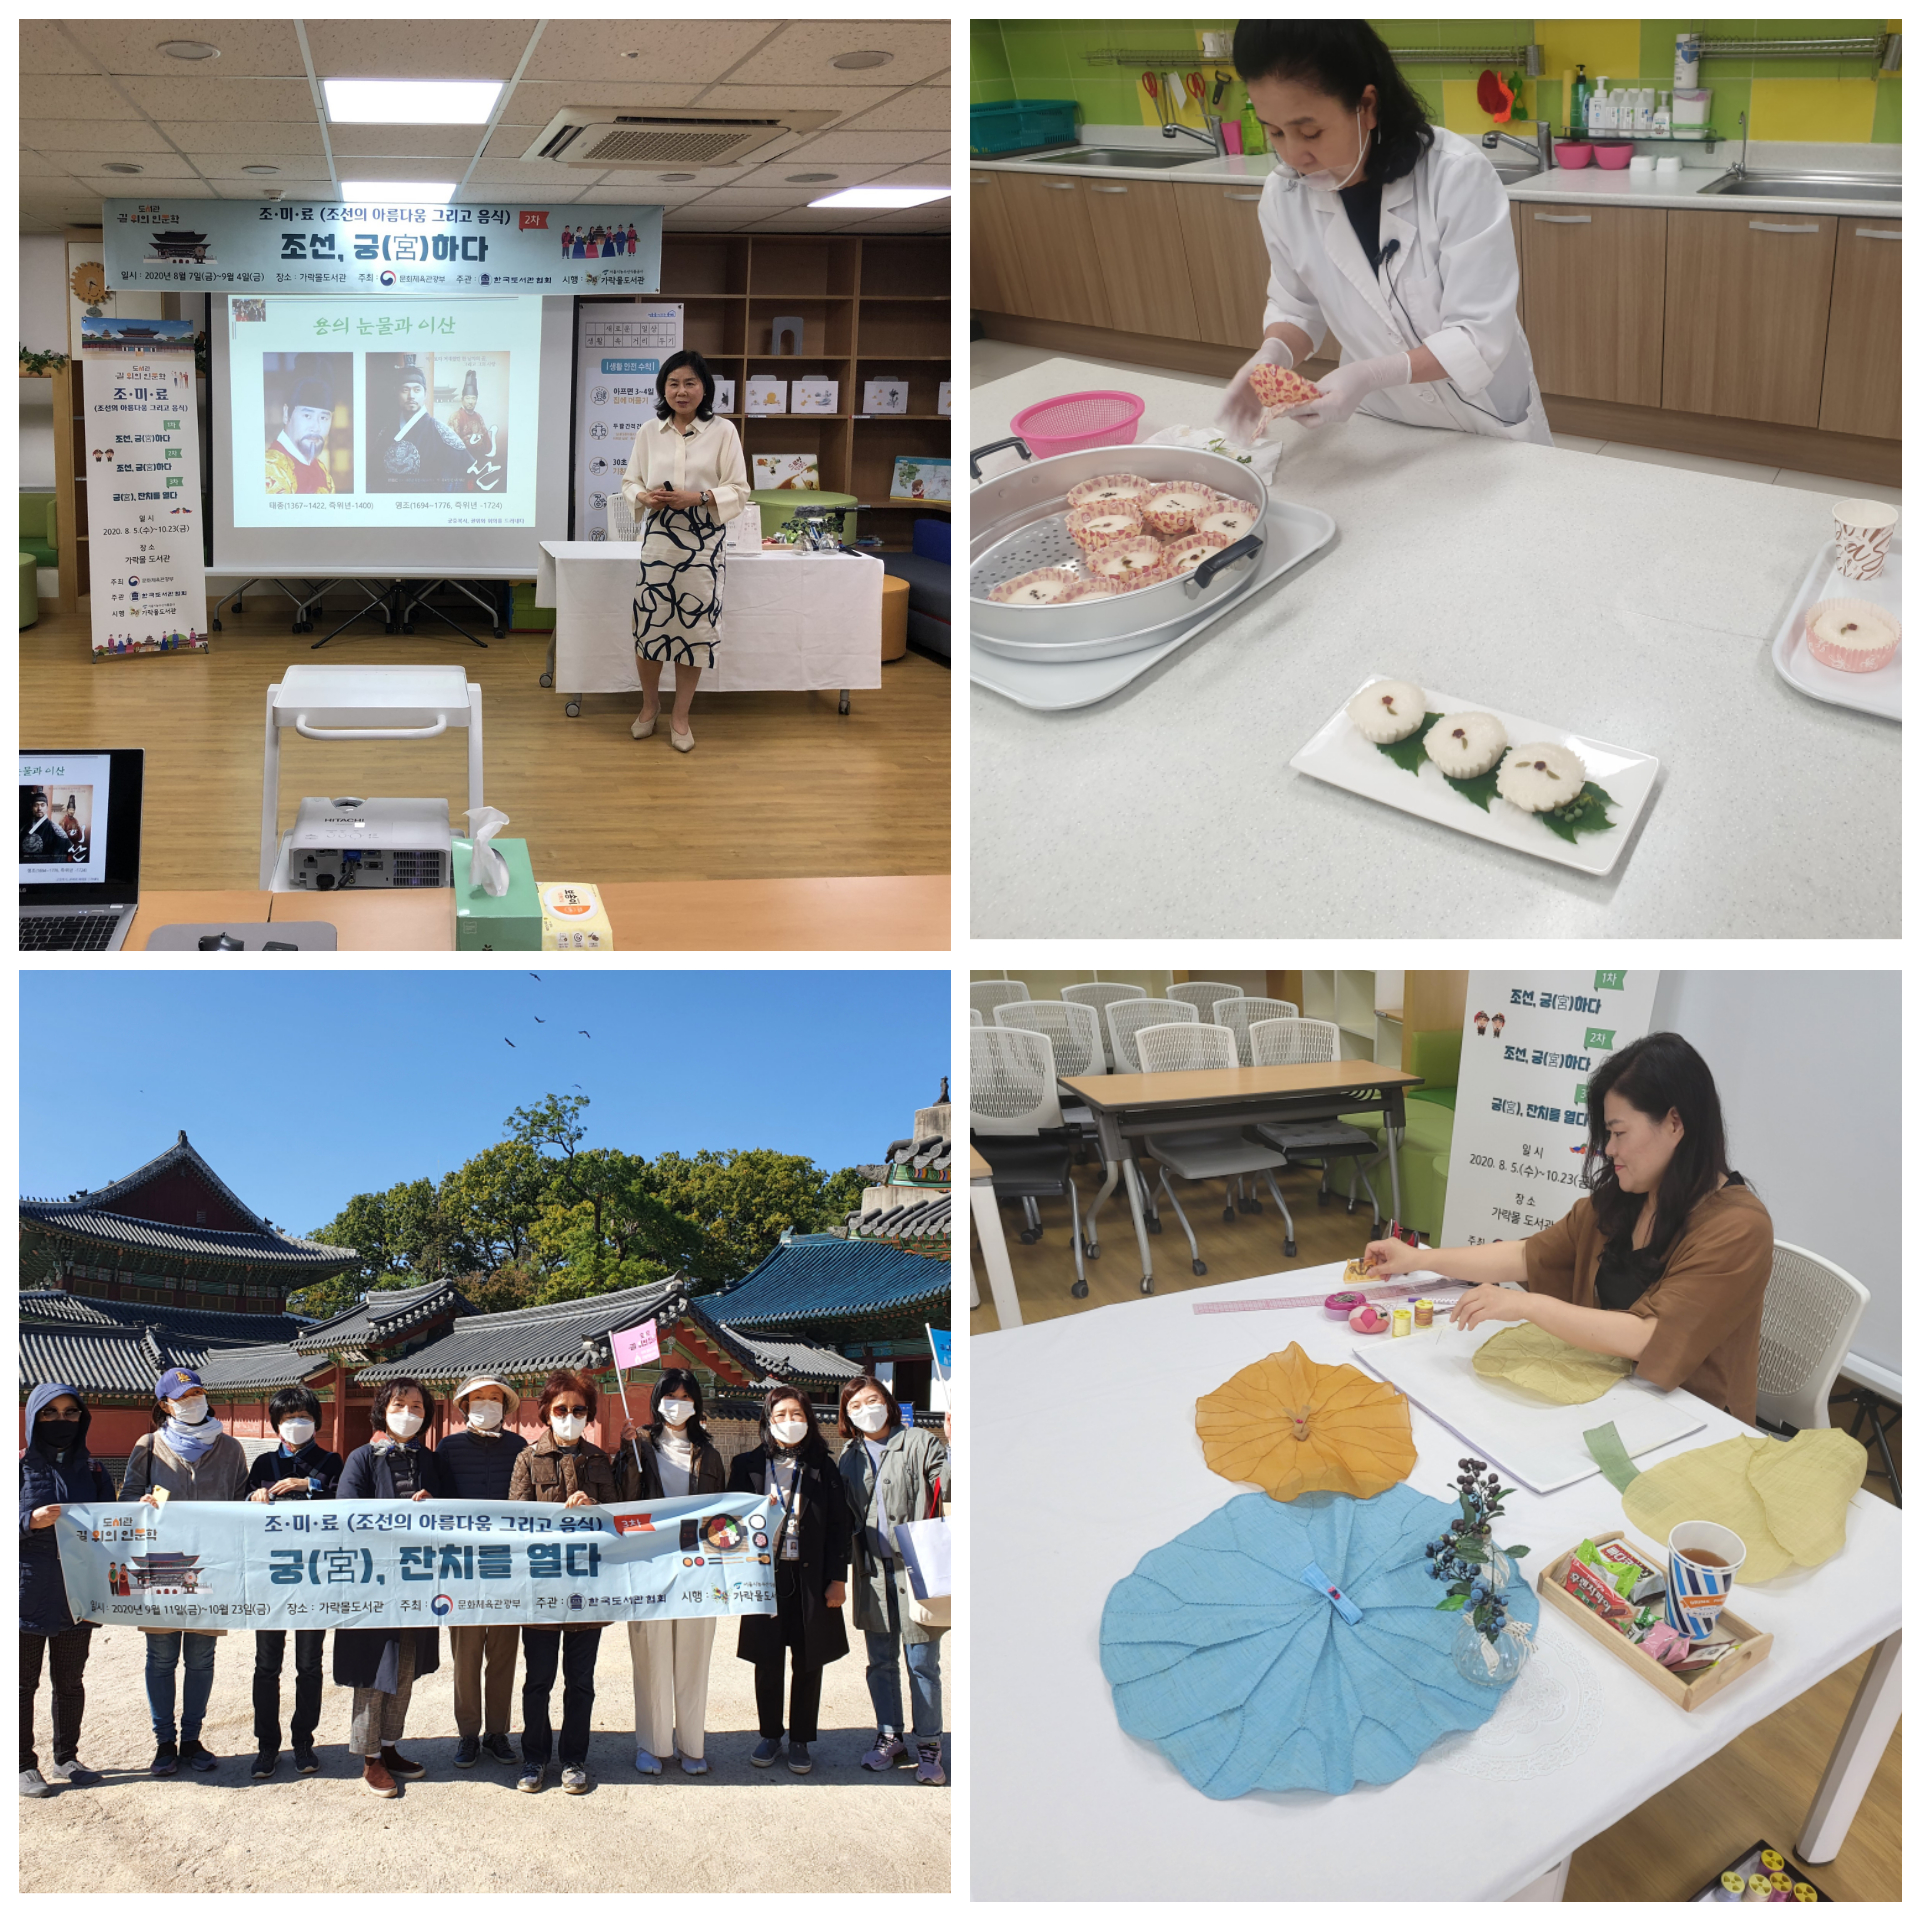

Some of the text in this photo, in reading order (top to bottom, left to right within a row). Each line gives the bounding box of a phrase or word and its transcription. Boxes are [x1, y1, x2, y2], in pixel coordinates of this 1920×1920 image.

[138, 205, 160, 213] 도서관
[116, 213, 180, 224] 길 위의 인문학
[320, 207, 367, 222] (조선의
[372, 208, 426, 223] 아름다움
[432, 209, 472, 223] 그리고
[476, 209, 511, 225] 음식)
[524, 215, 540, 226] 2차
[281, 233, 488, 263] 조선, 궁(宮)하다
[144, 271, 171, 281] 2020년
[173, 271, 186, 281] 8월
[188, 271, 234, 282] 7일(금)~9월
[236, 272, 265, 282] 4일(금)
[299, 273, 346, 283] 가락몰도서관
[399, 274, 445, 283] 문화체육관광부
[601, 276, 645, 285] 가락몰도서관
[313, 315, 456, 336] 용의 눈물과 이산
[610, 363, 652, 371] 생활 안전 수칙
[144, 372, 166, 380] 인문학
[115, 435, 133, 443] 조선,
[116, 464, 134, 472] 조선,
[138, 492, 160, 501] 잔치를
[162, 491, 177, 500] 열다
[125, 555, 170, 564] 가락몰 도서관
[142, 608, 176, 616] 가락몰도서관
[45, 766, 65, 776] 이산
[1602, 972, 1617, 986] 1차
[1510, 988, 1602, 1014] 조선, 궁(宮)하다
[1590, 1032, 1606, 1044] 2차
[1503, 1045, 1591, 1072] 조선, 궁(宮)하다
[1491, 1097, 1589, 1127] 궁(宮), 잔치를 열다
[1469, 1153, 1494, 1169] 2020.
[1491, 1207, 1521, 1224] 가락몰
[175, 1371, 191, 1382] LA
[103, 1517, 133, 1527] 도서관
[347, 1513, 411, 1532] (조선의
[419, 1514, 492, 1532] 아름다움
[500, 1516, 553, 1532] 그리고
[559, 1516, 603, 1532] 음식)
[621, 1519, 641, 1529] 3차
[76, 1528, 157, 1542] 길 위의 인문학
[269, 1542, 601, 1585] 궁(宮), 잔치를 열다
[733, 1590, 776, 1602] 가락몰도서
[1570, 1572, 1611, 1612] 후렌치파이
[112, 1604, 144, 1616] 2020년
[146, 1604, 161, 1615] 9월
[164, 1603, 229, 1616] 11일(금)~10월
[231, 1603, 271, 1616] 23일(금)
[318, 1601, 384, 1615] 가락몰도서관
[457, 1599, 521, 1611] 문화체육관광부
